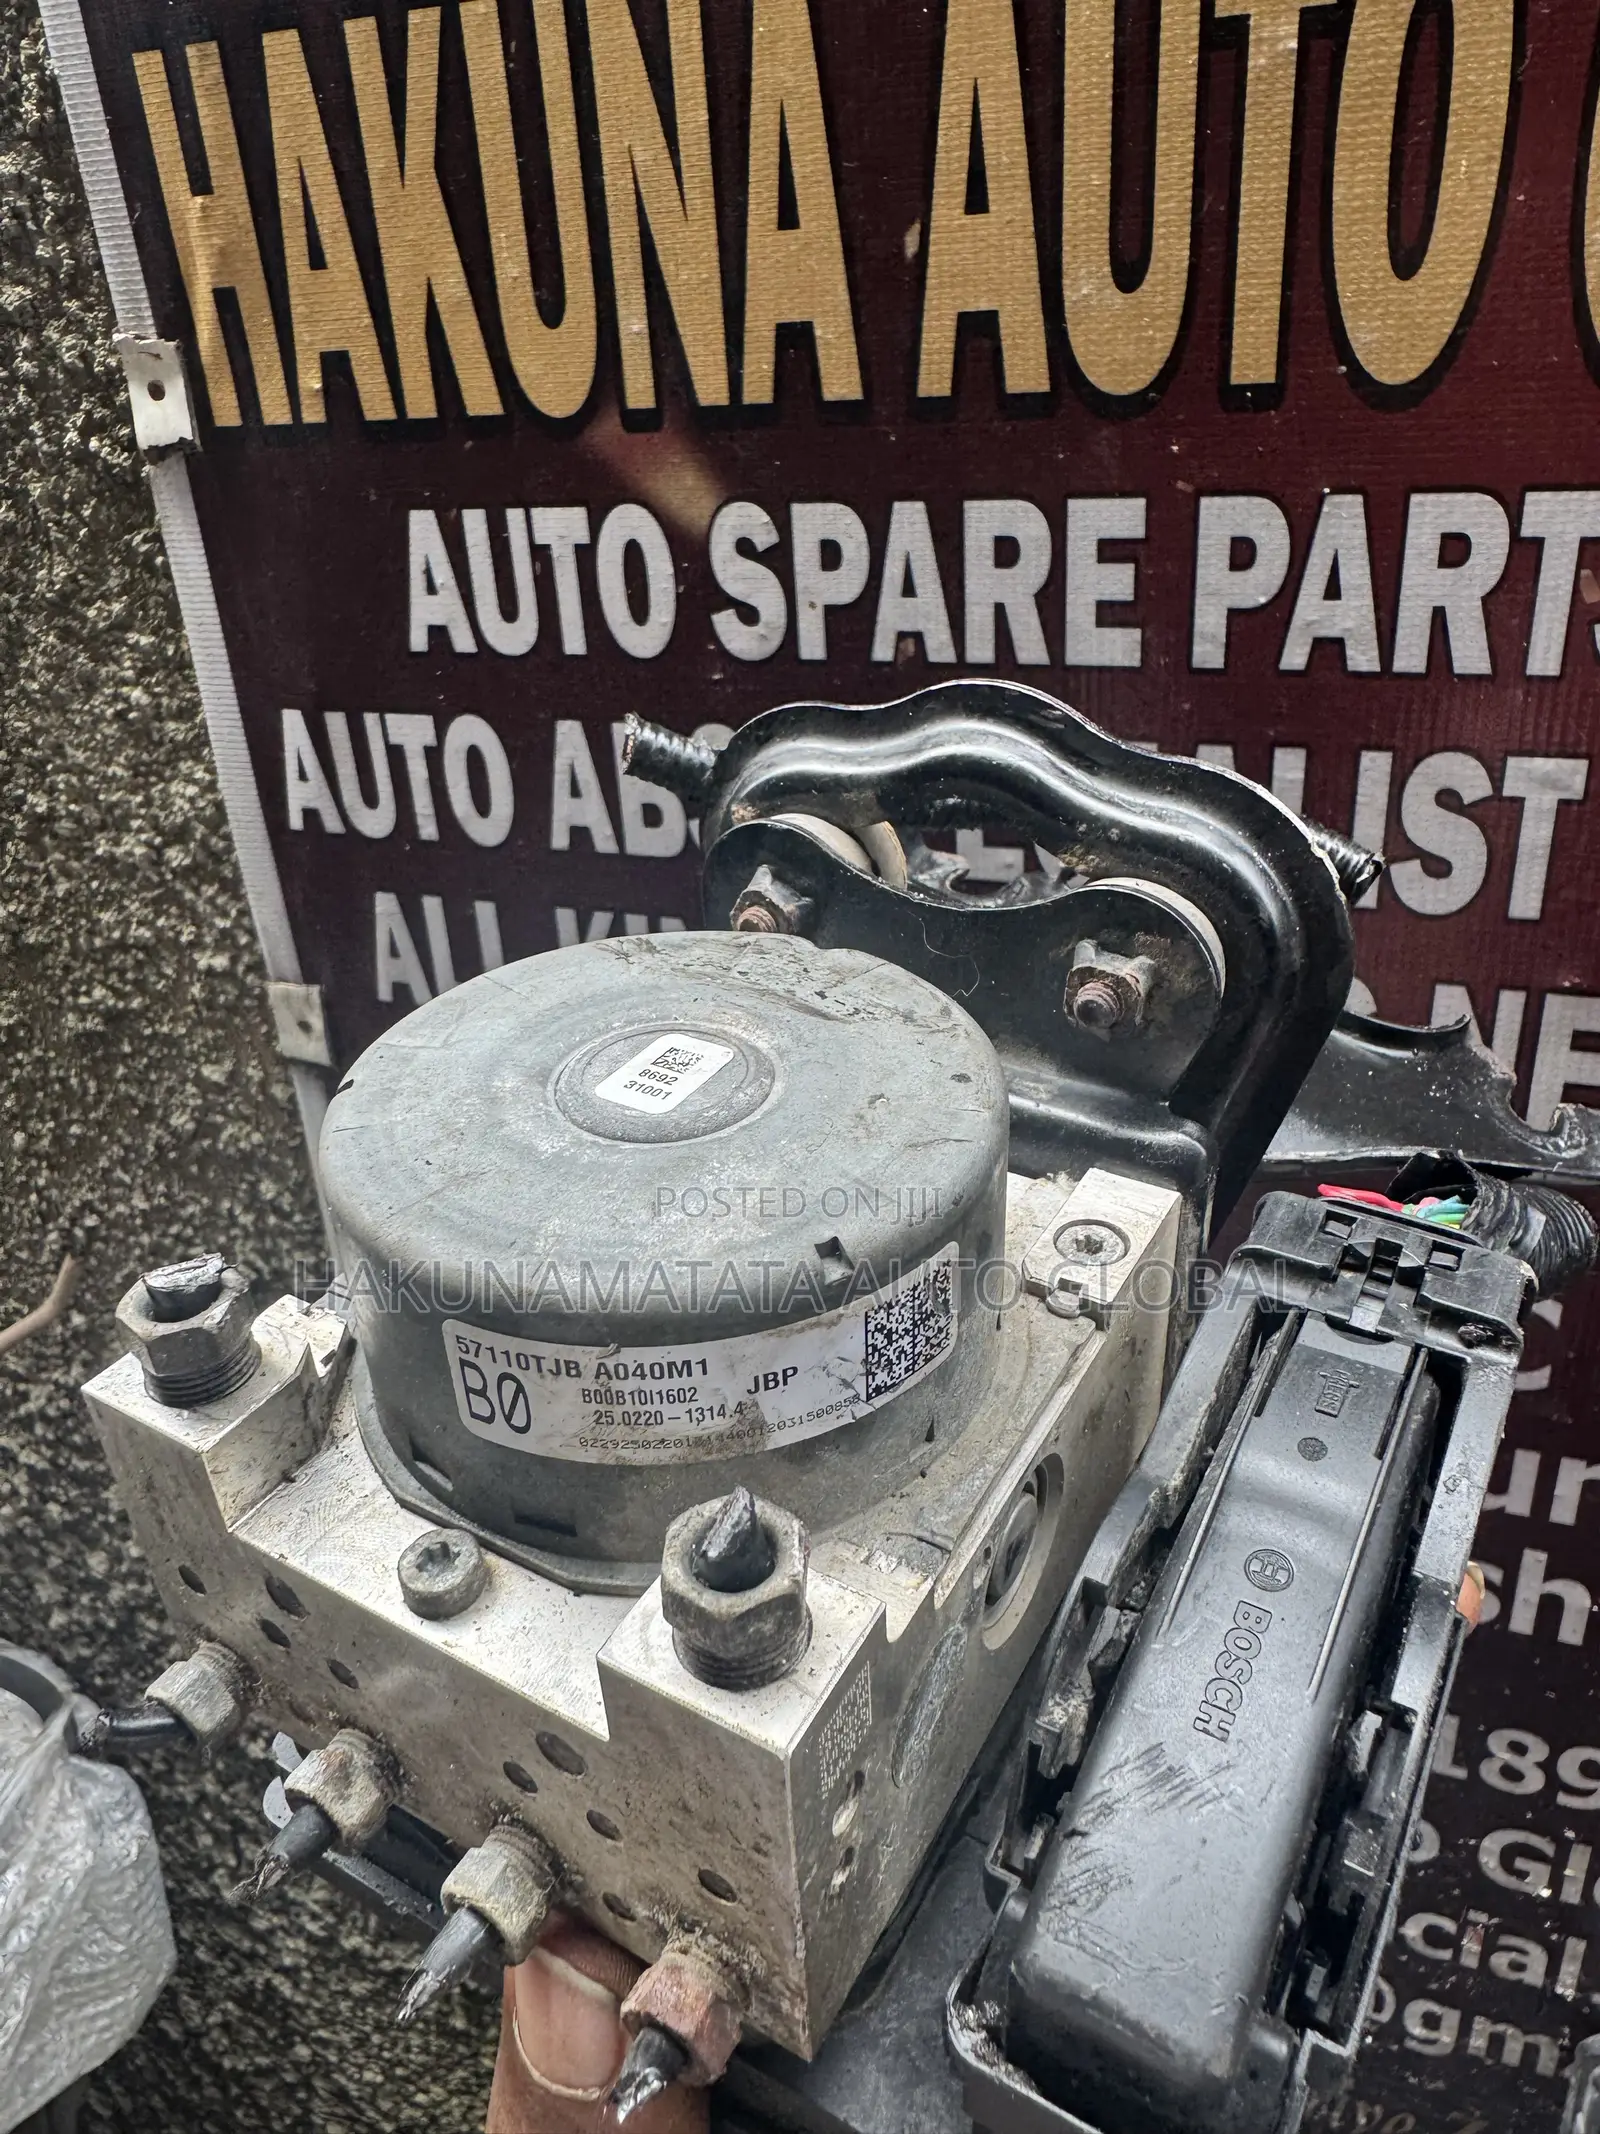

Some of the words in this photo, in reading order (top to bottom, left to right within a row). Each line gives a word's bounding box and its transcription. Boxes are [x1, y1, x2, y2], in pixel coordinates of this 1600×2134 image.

[132, 0, 863, 427] HAKUNA
[916, 0, 1514, 396] AUTO
[408, 503, 677, 659] AUTO
[709, 497, 1146, 669] SPARE
[1191, 490, 1600, 677] PART
[281, 708, 514, 848] AUTO
[550, 719, 738, 859] AB
[623, 1080, 673, 1100] 31001
[637, 1069, 679, 1086] 8692
[455, 1334, 582, 1379] 57110TJB
[595, 1358, 708, 1381] A040M1
[746, 1366, 799, 1395] JBP
[1193, 1600, 1273, 1742] BOSCH
